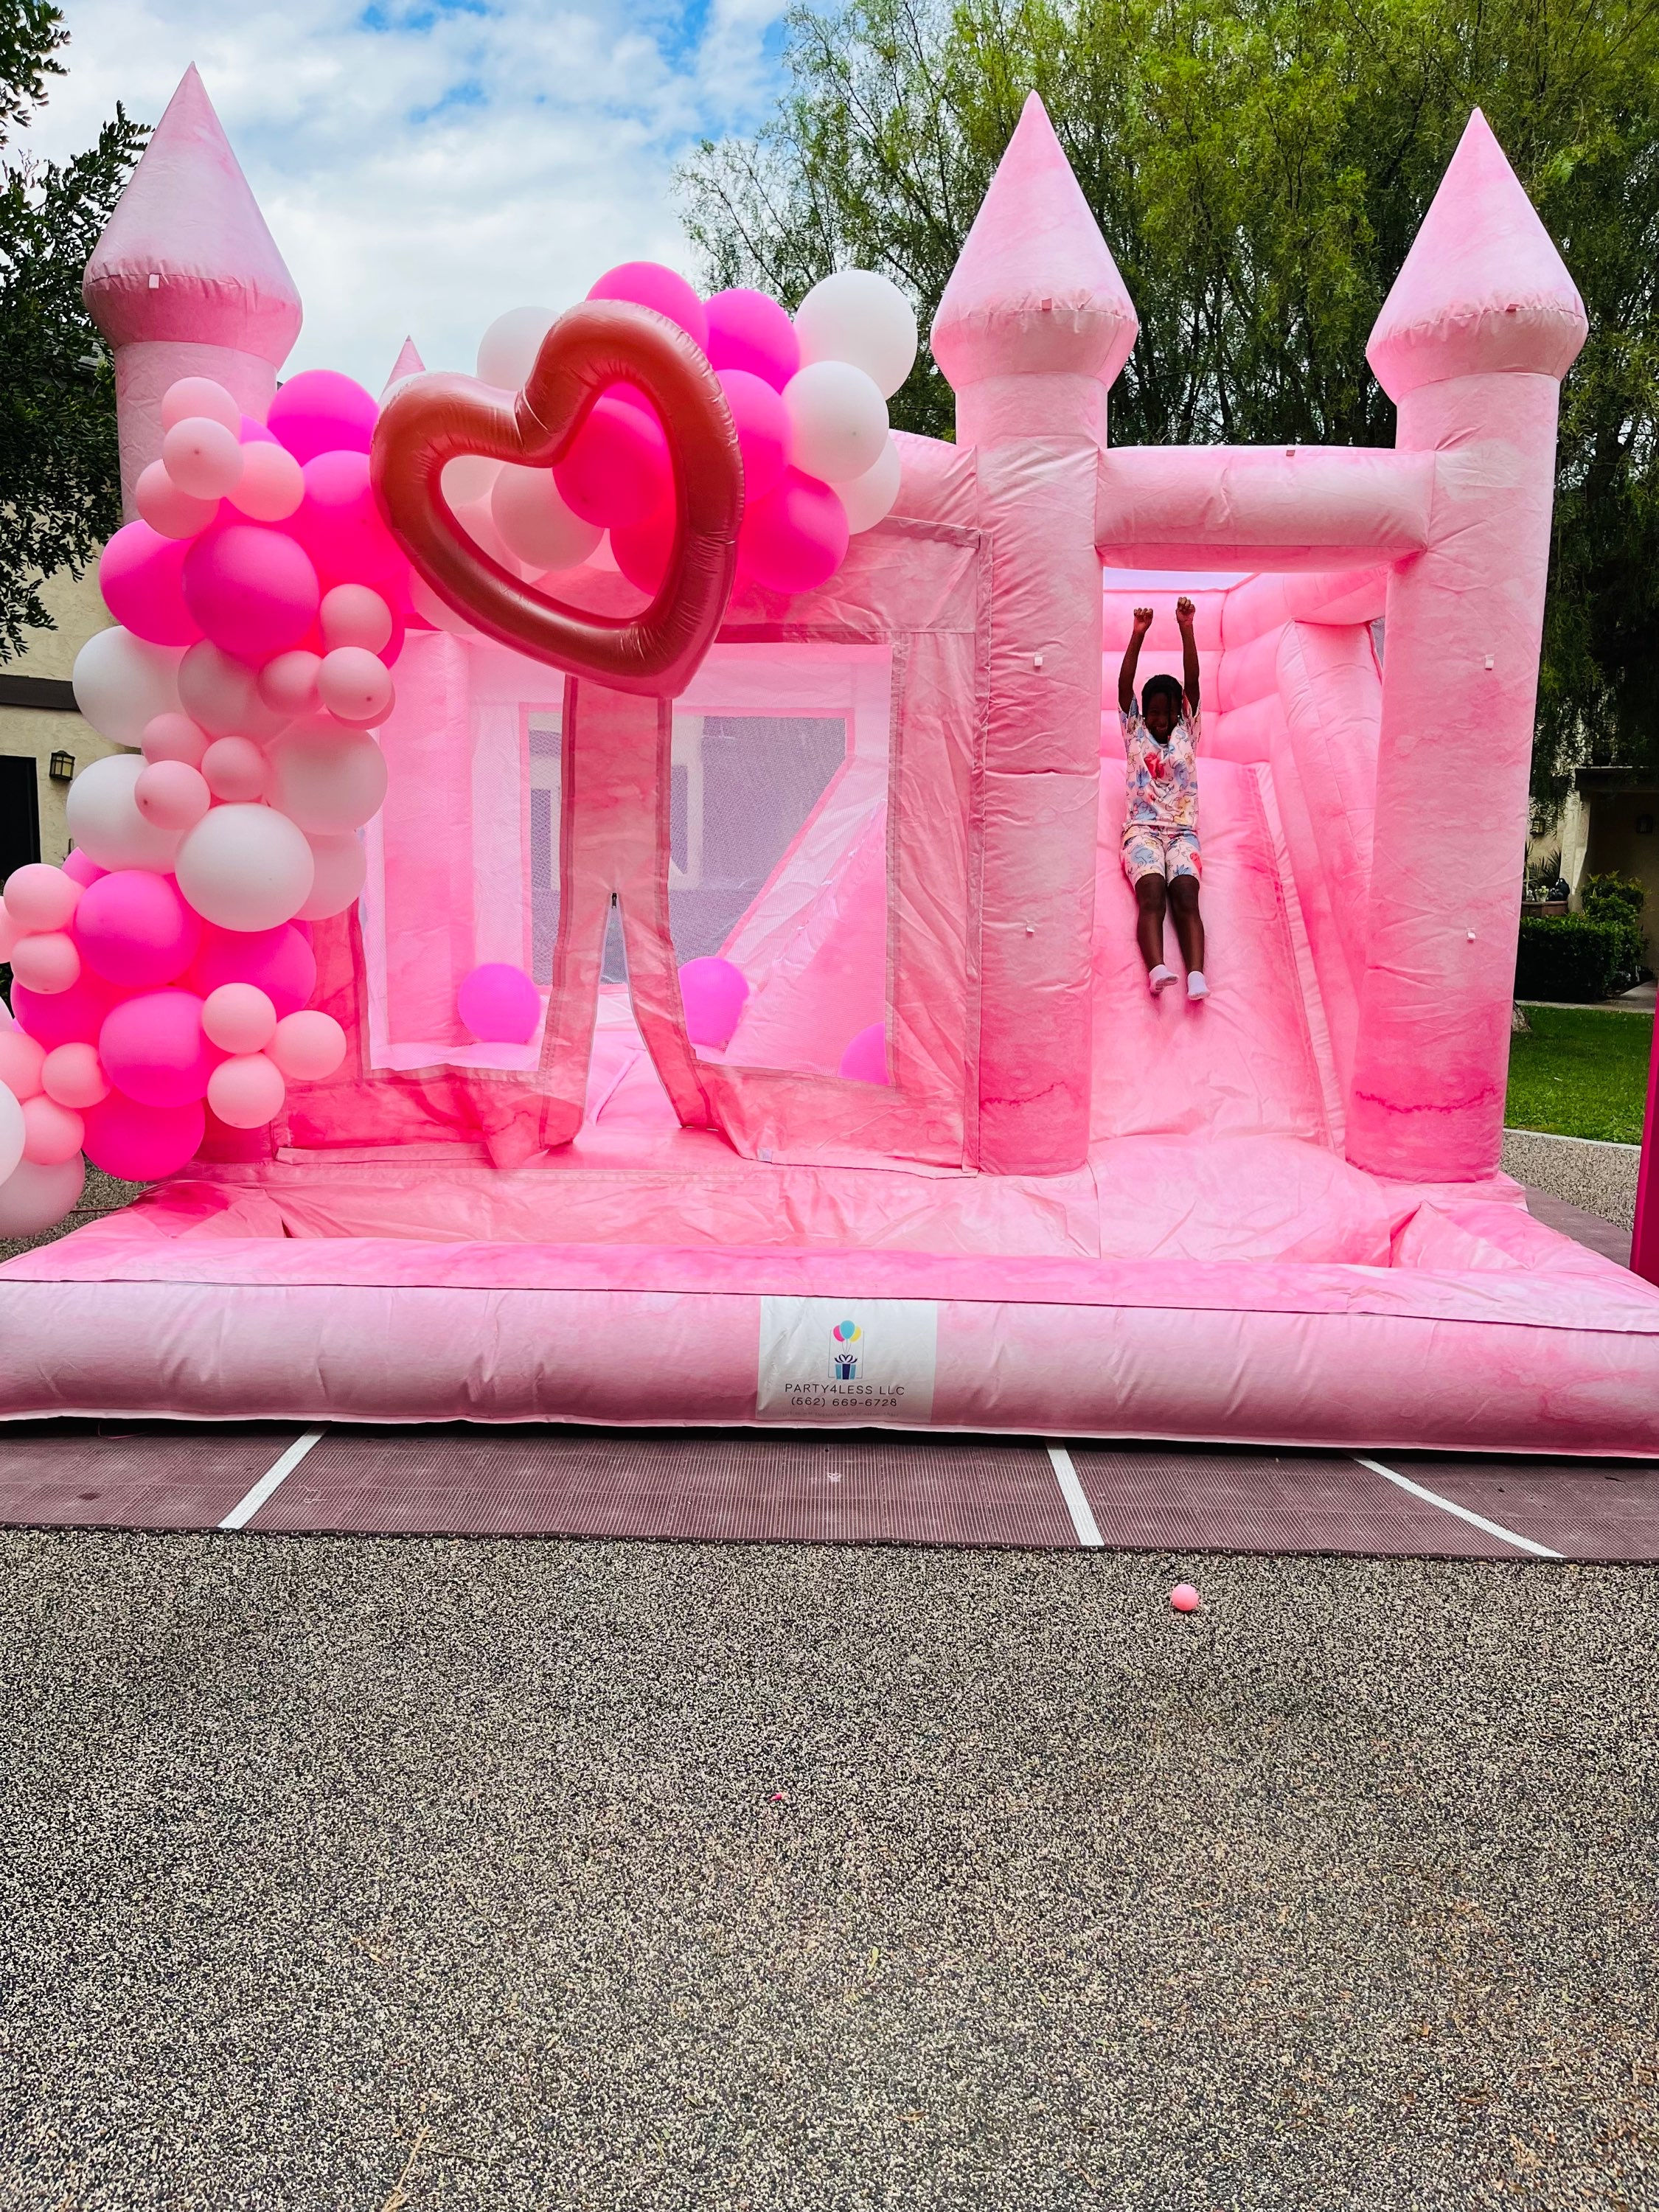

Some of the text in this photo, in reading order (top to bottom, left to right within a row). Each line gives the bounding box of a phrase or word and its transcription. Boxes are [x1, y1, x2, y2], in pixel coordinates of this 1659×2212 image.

[785, 1383, 905, 1395] PARTY4LESS LLC
[791, 1397, 897, 1407] (562) 669-6728
